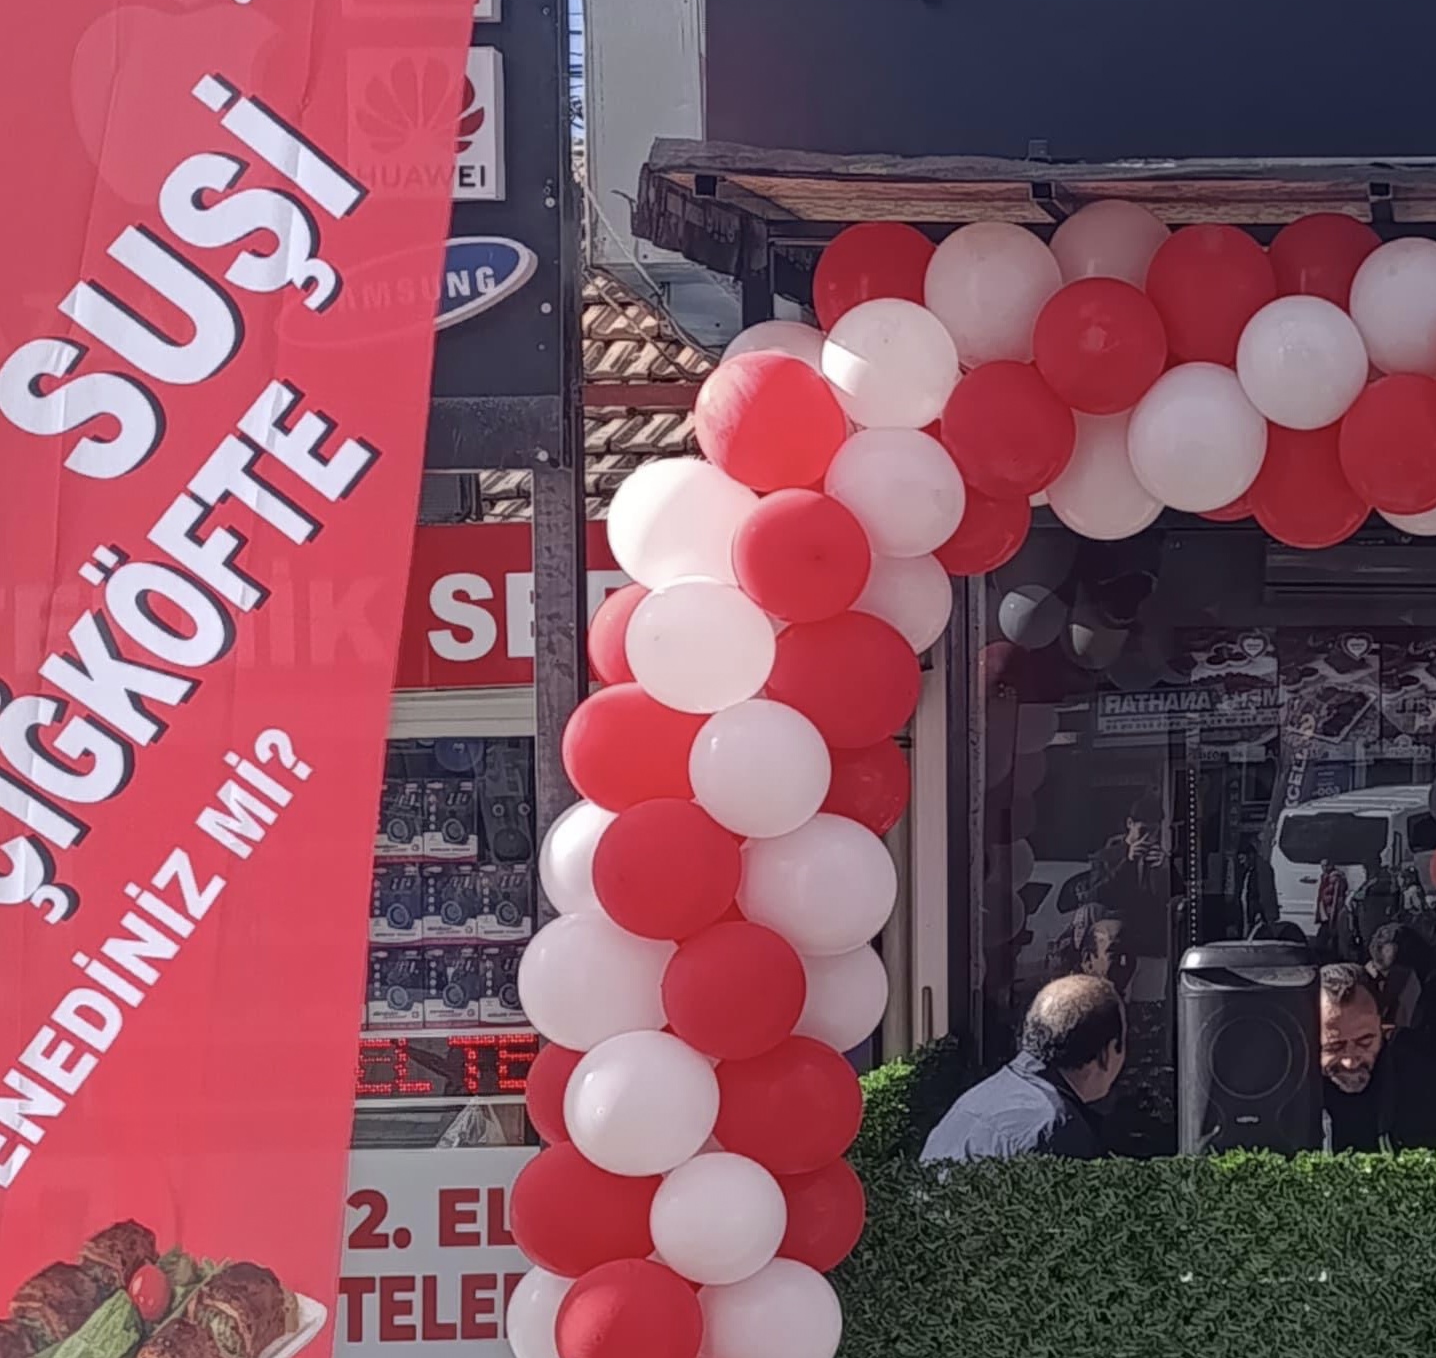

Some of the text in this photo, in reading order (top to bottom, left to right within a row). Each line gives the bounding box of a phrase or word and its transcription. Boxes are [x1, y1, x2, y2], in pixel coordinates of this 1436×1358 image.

[0, 74, 369, 479] SUŞİ
[338, 265, 497, 312] AMSUNG
[0, 849, 226, 1190] NEDİNİZ
[197, 728, 313, 859] Mİ?
[346, 1188, 413, 1250] 2.
